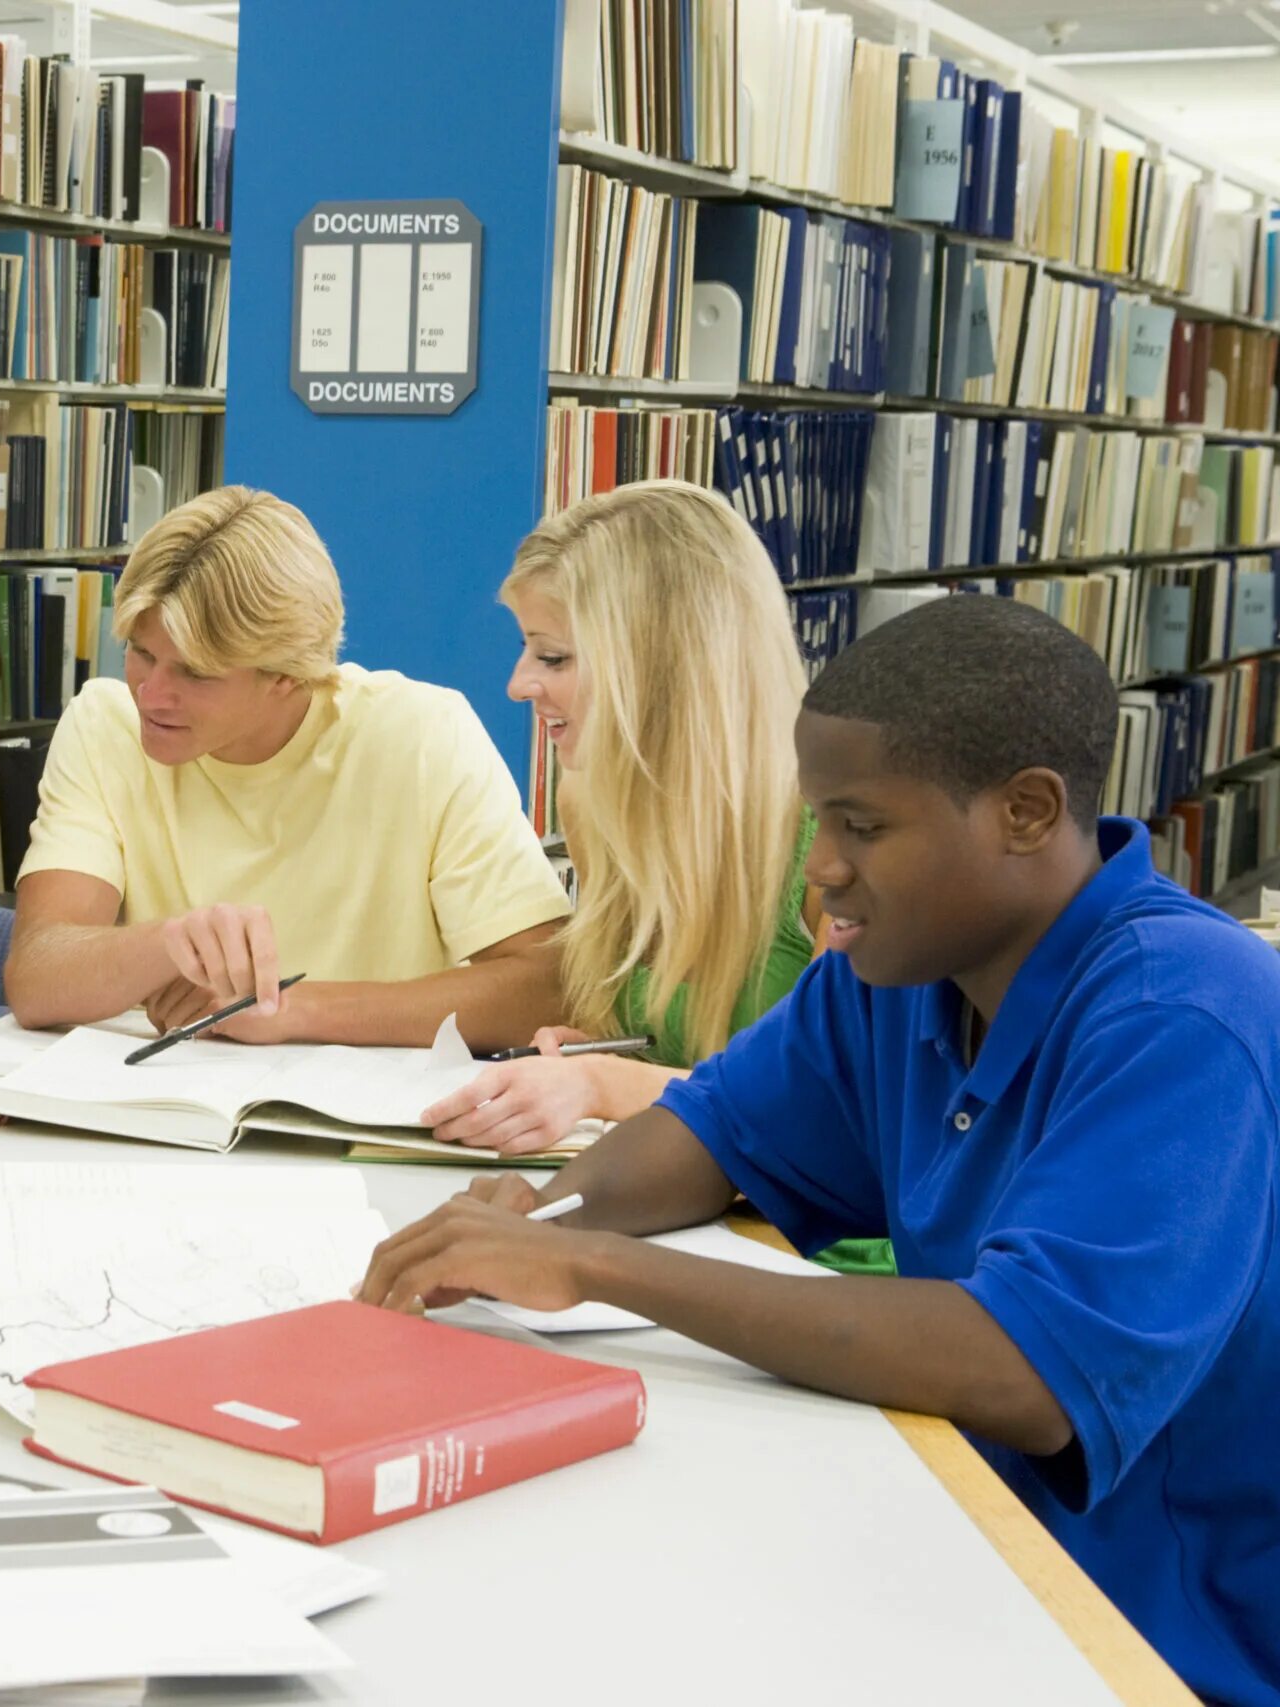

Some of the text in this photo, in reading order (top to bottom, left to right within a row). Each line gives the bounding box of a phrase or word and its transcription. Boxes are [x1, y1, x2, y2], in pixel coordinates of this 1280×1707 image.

[923, 149, 959, 166] 1956
[313, 212, 461, 235] DOCUMENTS
[308, 381, 455, 403] DOCUMENTS
